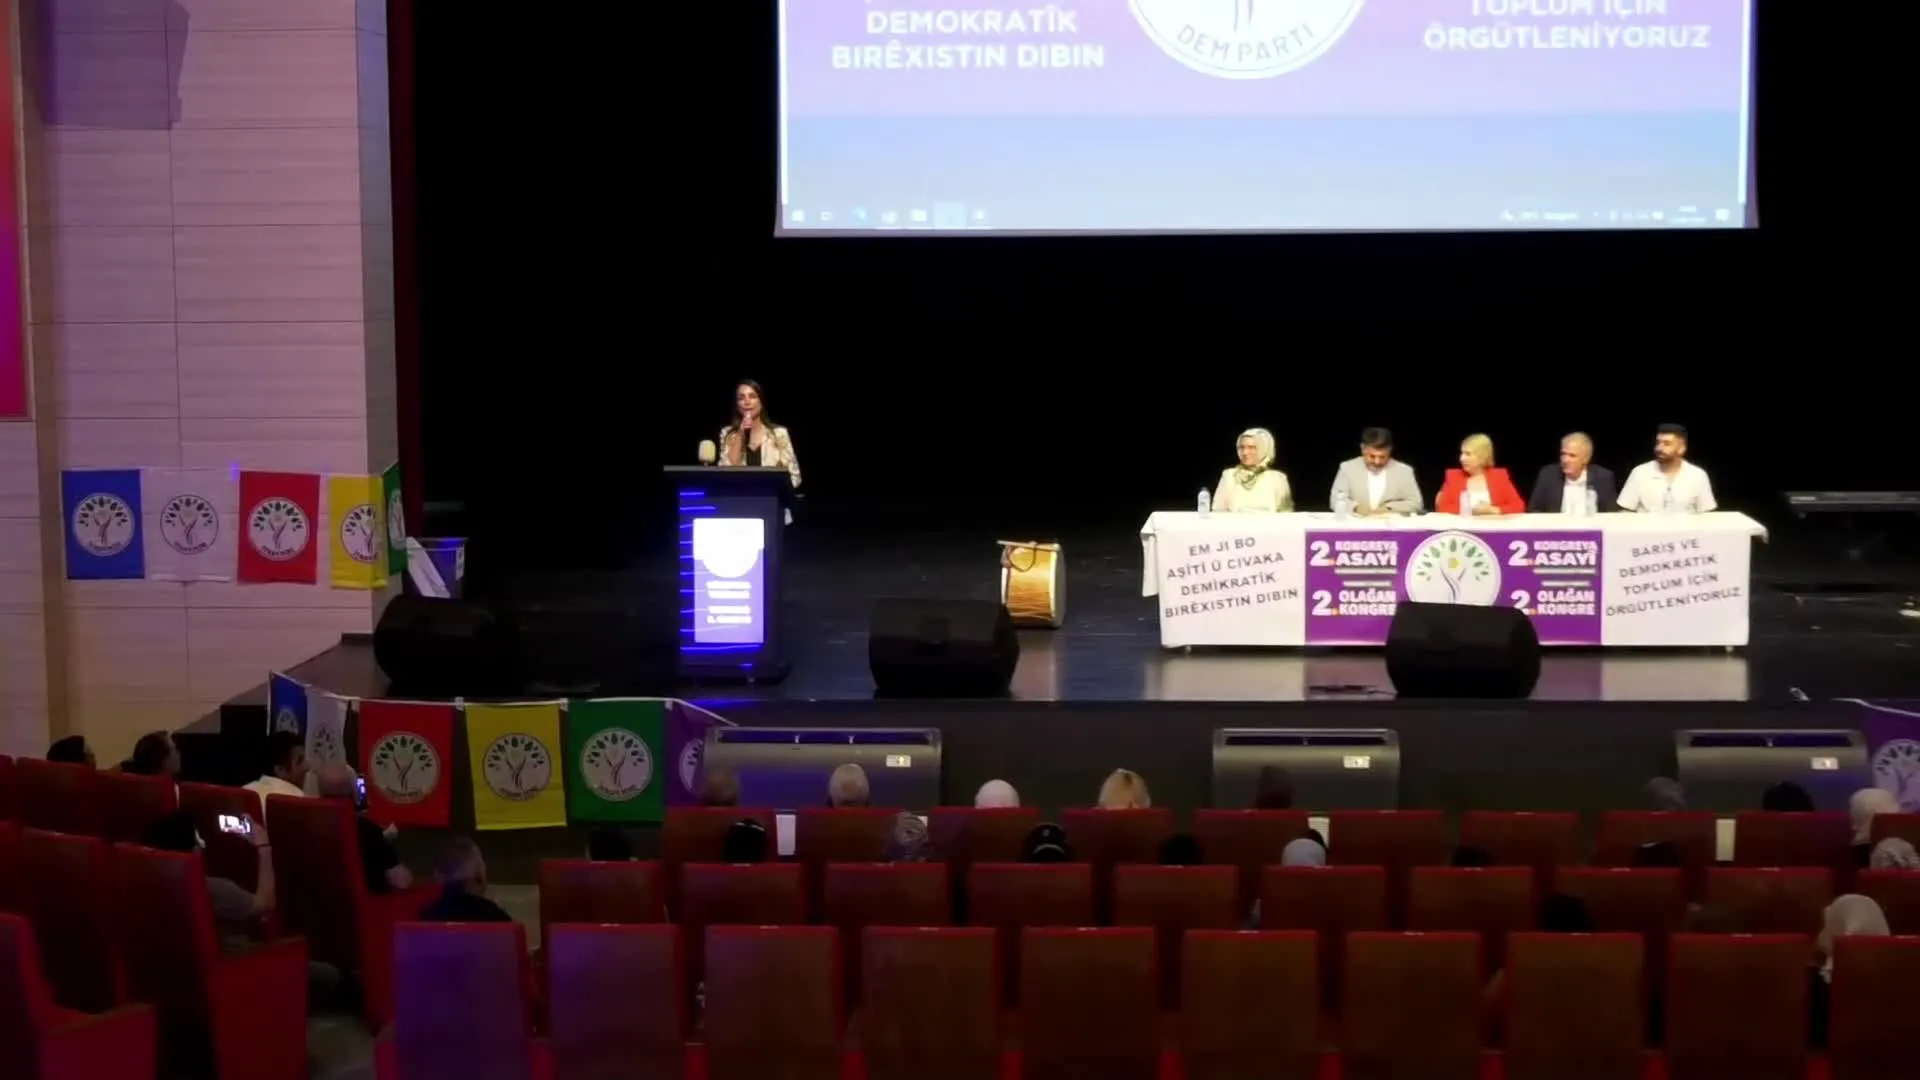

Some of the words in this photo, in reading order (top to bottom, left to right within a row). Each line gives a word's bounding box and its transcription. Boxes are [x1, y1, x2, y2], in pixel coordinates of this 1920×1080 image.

[1177, 24, 1230, 61] DEM
[1017, 44, 1105, 69] DIBIN
[1188, 543, 1210, 556] EM
[1234, 537, 1256, 549] BO
[1681, 538, 1700, 550] VE
[1623, 578, 1683, 596] TOPLUM
[1339, 603, 1397, 616] KONGRE
[1537, 603, 1595, 615] KONGRE
